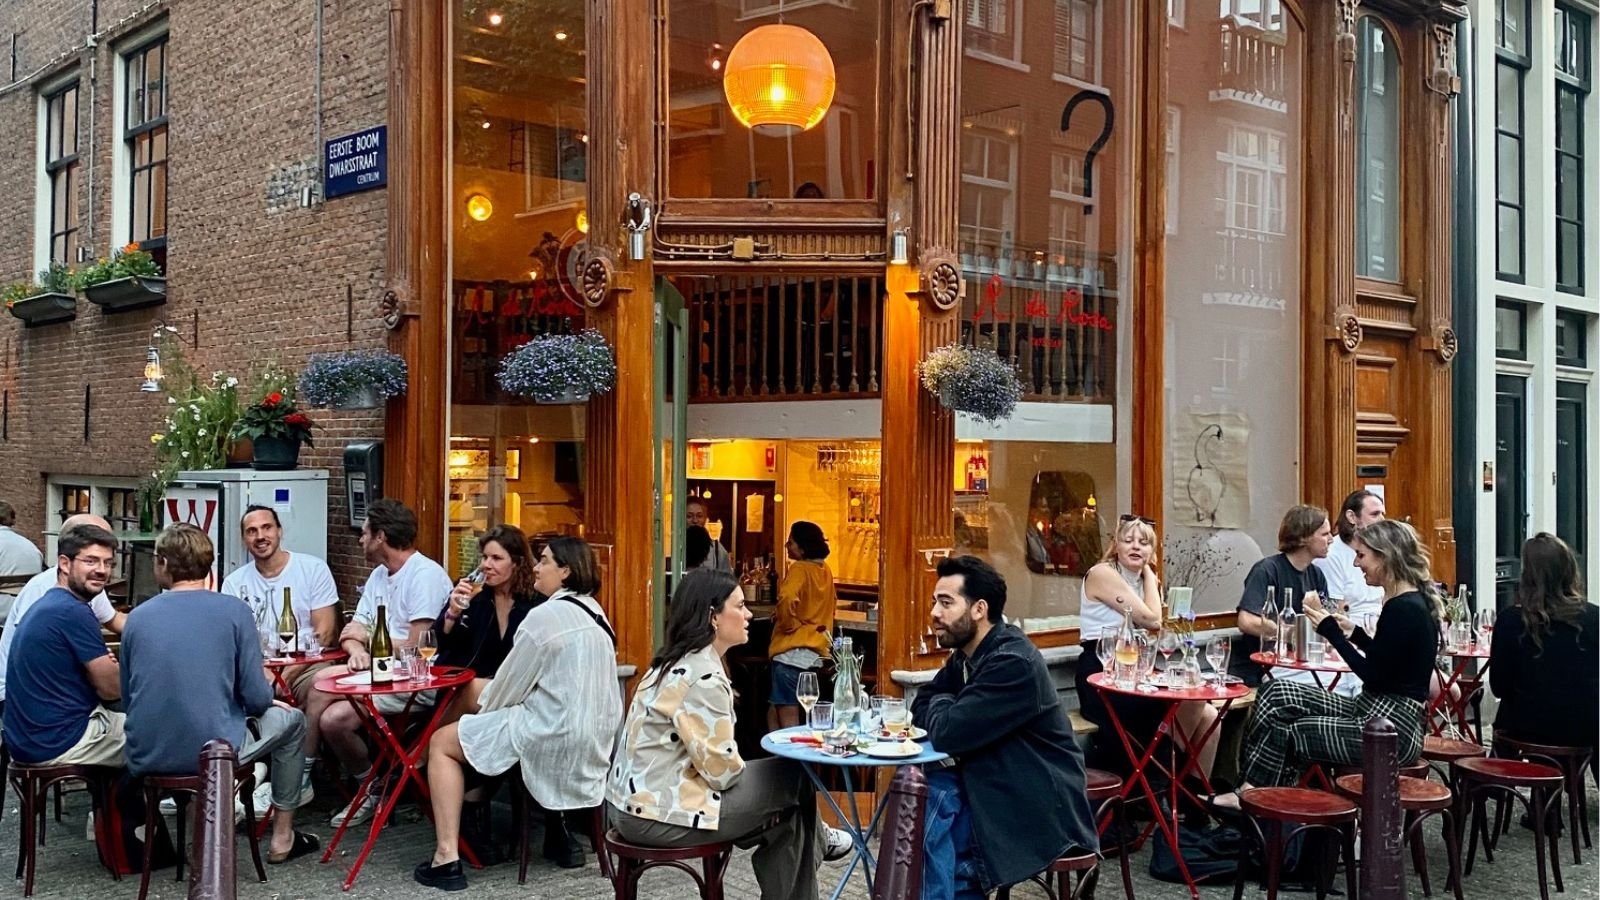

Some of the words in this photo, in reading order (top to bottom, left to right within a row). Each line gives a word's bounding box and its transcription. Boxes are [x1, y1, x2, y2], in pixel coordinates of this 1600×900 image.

[329, 138, 354, 160] EERSTE
[356, 131, 379, 152] BOOM
[329, 151, 378, 179] DWARSSTRAAT
[357, 172, 379, 184] CENTRUM
[1057, 288, 1113, 331] Rosa
